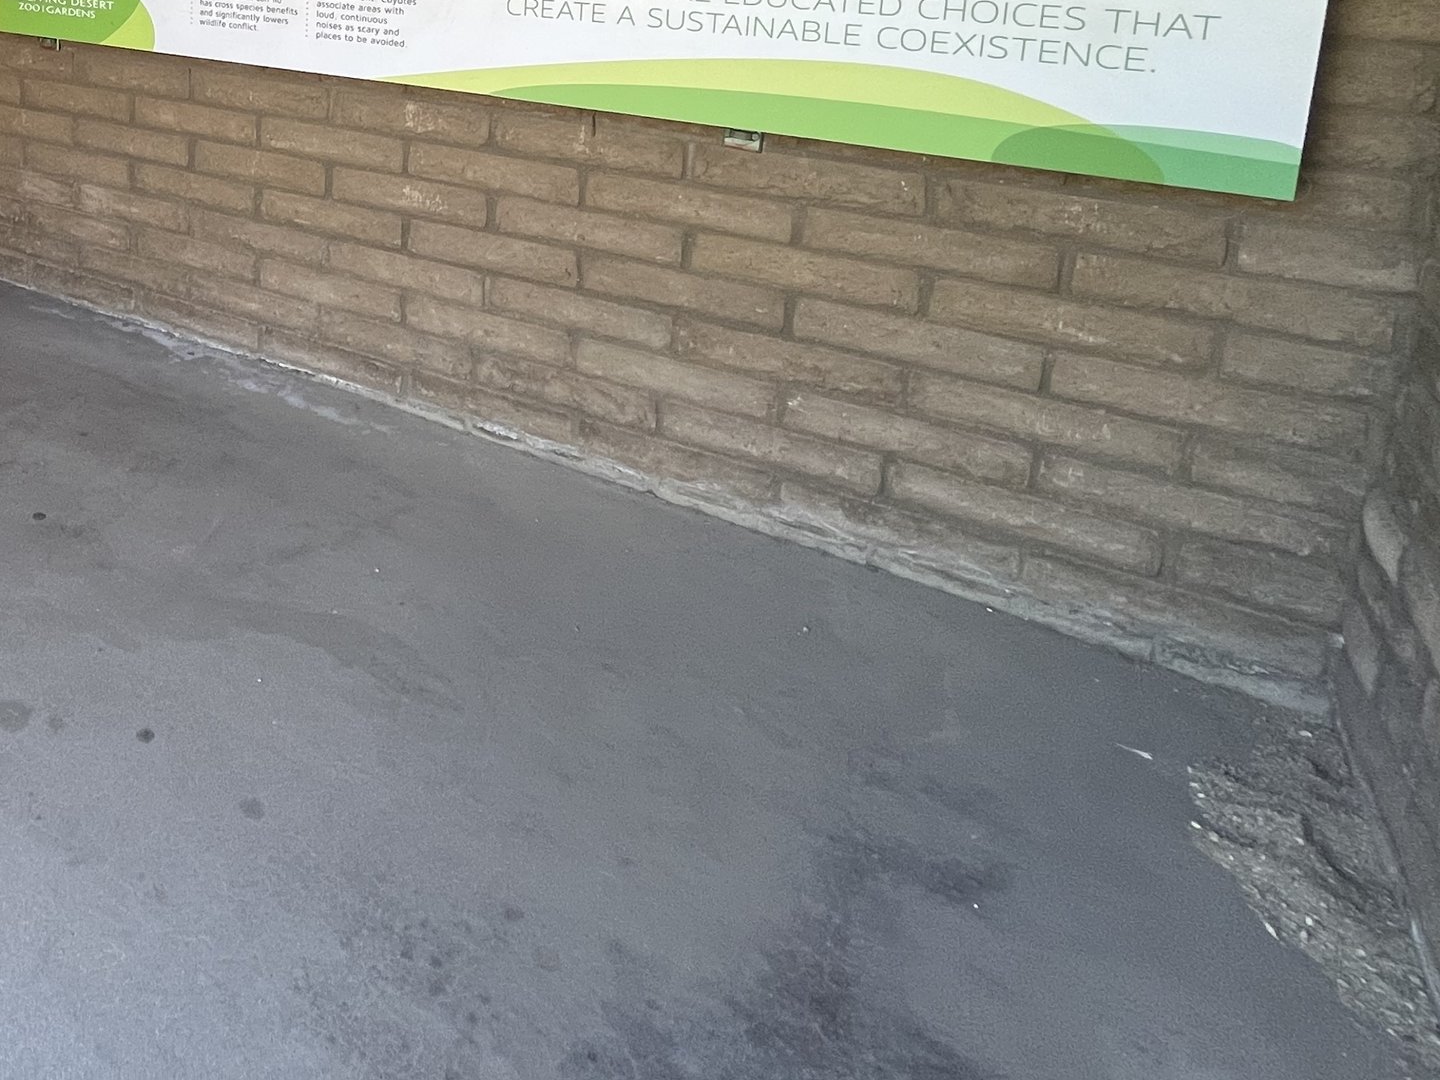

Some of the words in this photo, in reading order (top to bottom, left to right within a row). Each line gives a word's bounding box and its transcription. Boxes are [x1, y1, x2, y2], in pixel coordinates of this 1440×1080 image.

[18, 1, 41, 12] ZOO
[44, 4, 96, 19] GARDENS
[315, 0, 355, 11] associate
[357, 4, 381, 13] areas
[383, 6, 405, 15] with
[339, 13, 388, 25] continuous
[1104, 8, 1222, 41] THAT
[315, 20, 343, 31] noises
[344, 24, 355, 32] as
[356, 25, 380, 37] scary
[382, 28, 400, 37] and
[314, 31, 342, 41] places
[343, 33, 354, 42] to
[355, 34, 368, 44] be
[615, 4, 636, 26] A
[646, 6, 863, 47] SUSTAINABLE
[876, 25, 1156, 73] COEXISTENCE.
